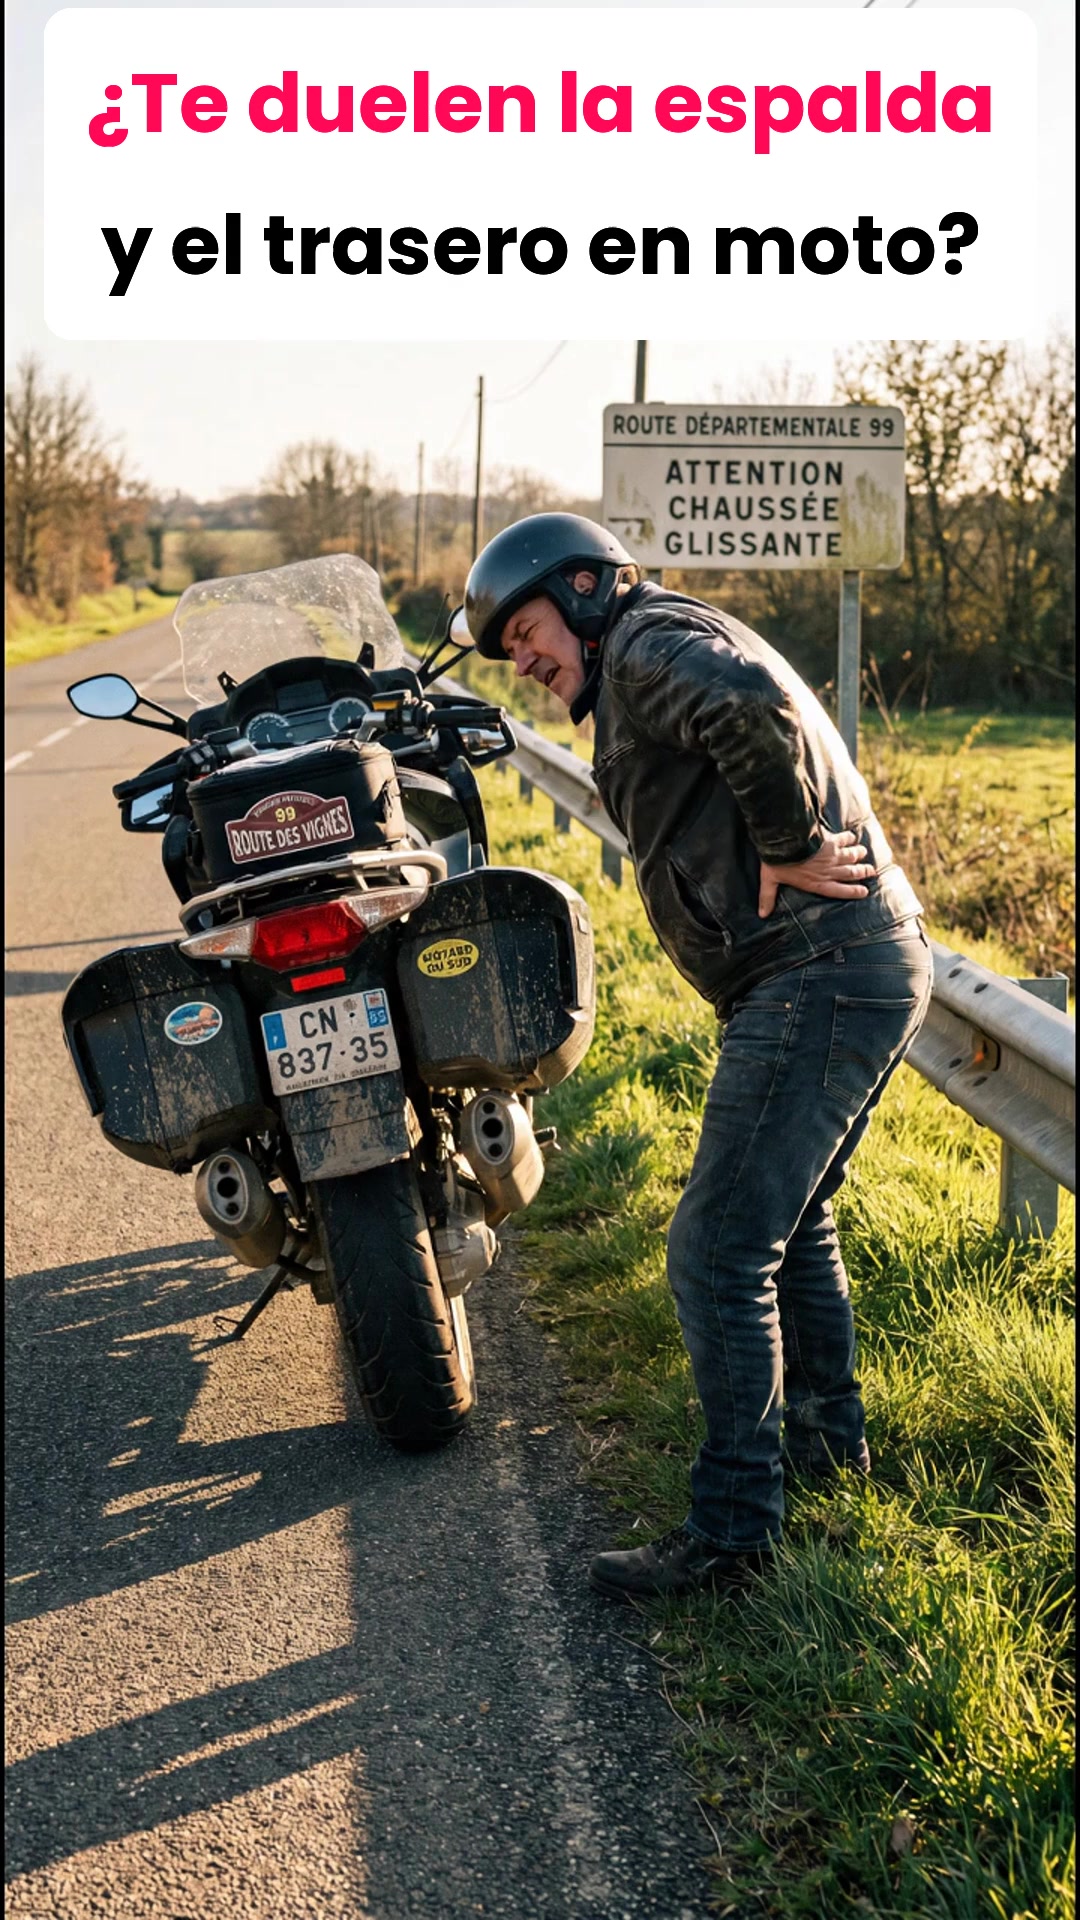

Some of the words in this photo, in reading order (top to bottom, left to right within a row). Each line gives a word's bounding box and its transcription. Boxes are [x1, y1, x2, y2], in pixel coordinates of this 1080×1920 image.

[613, 415, 676, 435] ROUTE
[686, 412, 861, 437] DÉPARTEMENTALE
[869, 418, 895, 437] 99
[665, 460, 843, 485] ATTENTION
[669, 491, 840, 521] CHAUSSÉE
[665, 531, 842, 556] GLISSANTE
[274, 806, 297, 823] 99
[230, 829, 276, 857] ROUTE
[275, 826, 301, 849] DES
[301, 805, 349, 842] VIGNES
[299, 1005, 338, 1038] CN
